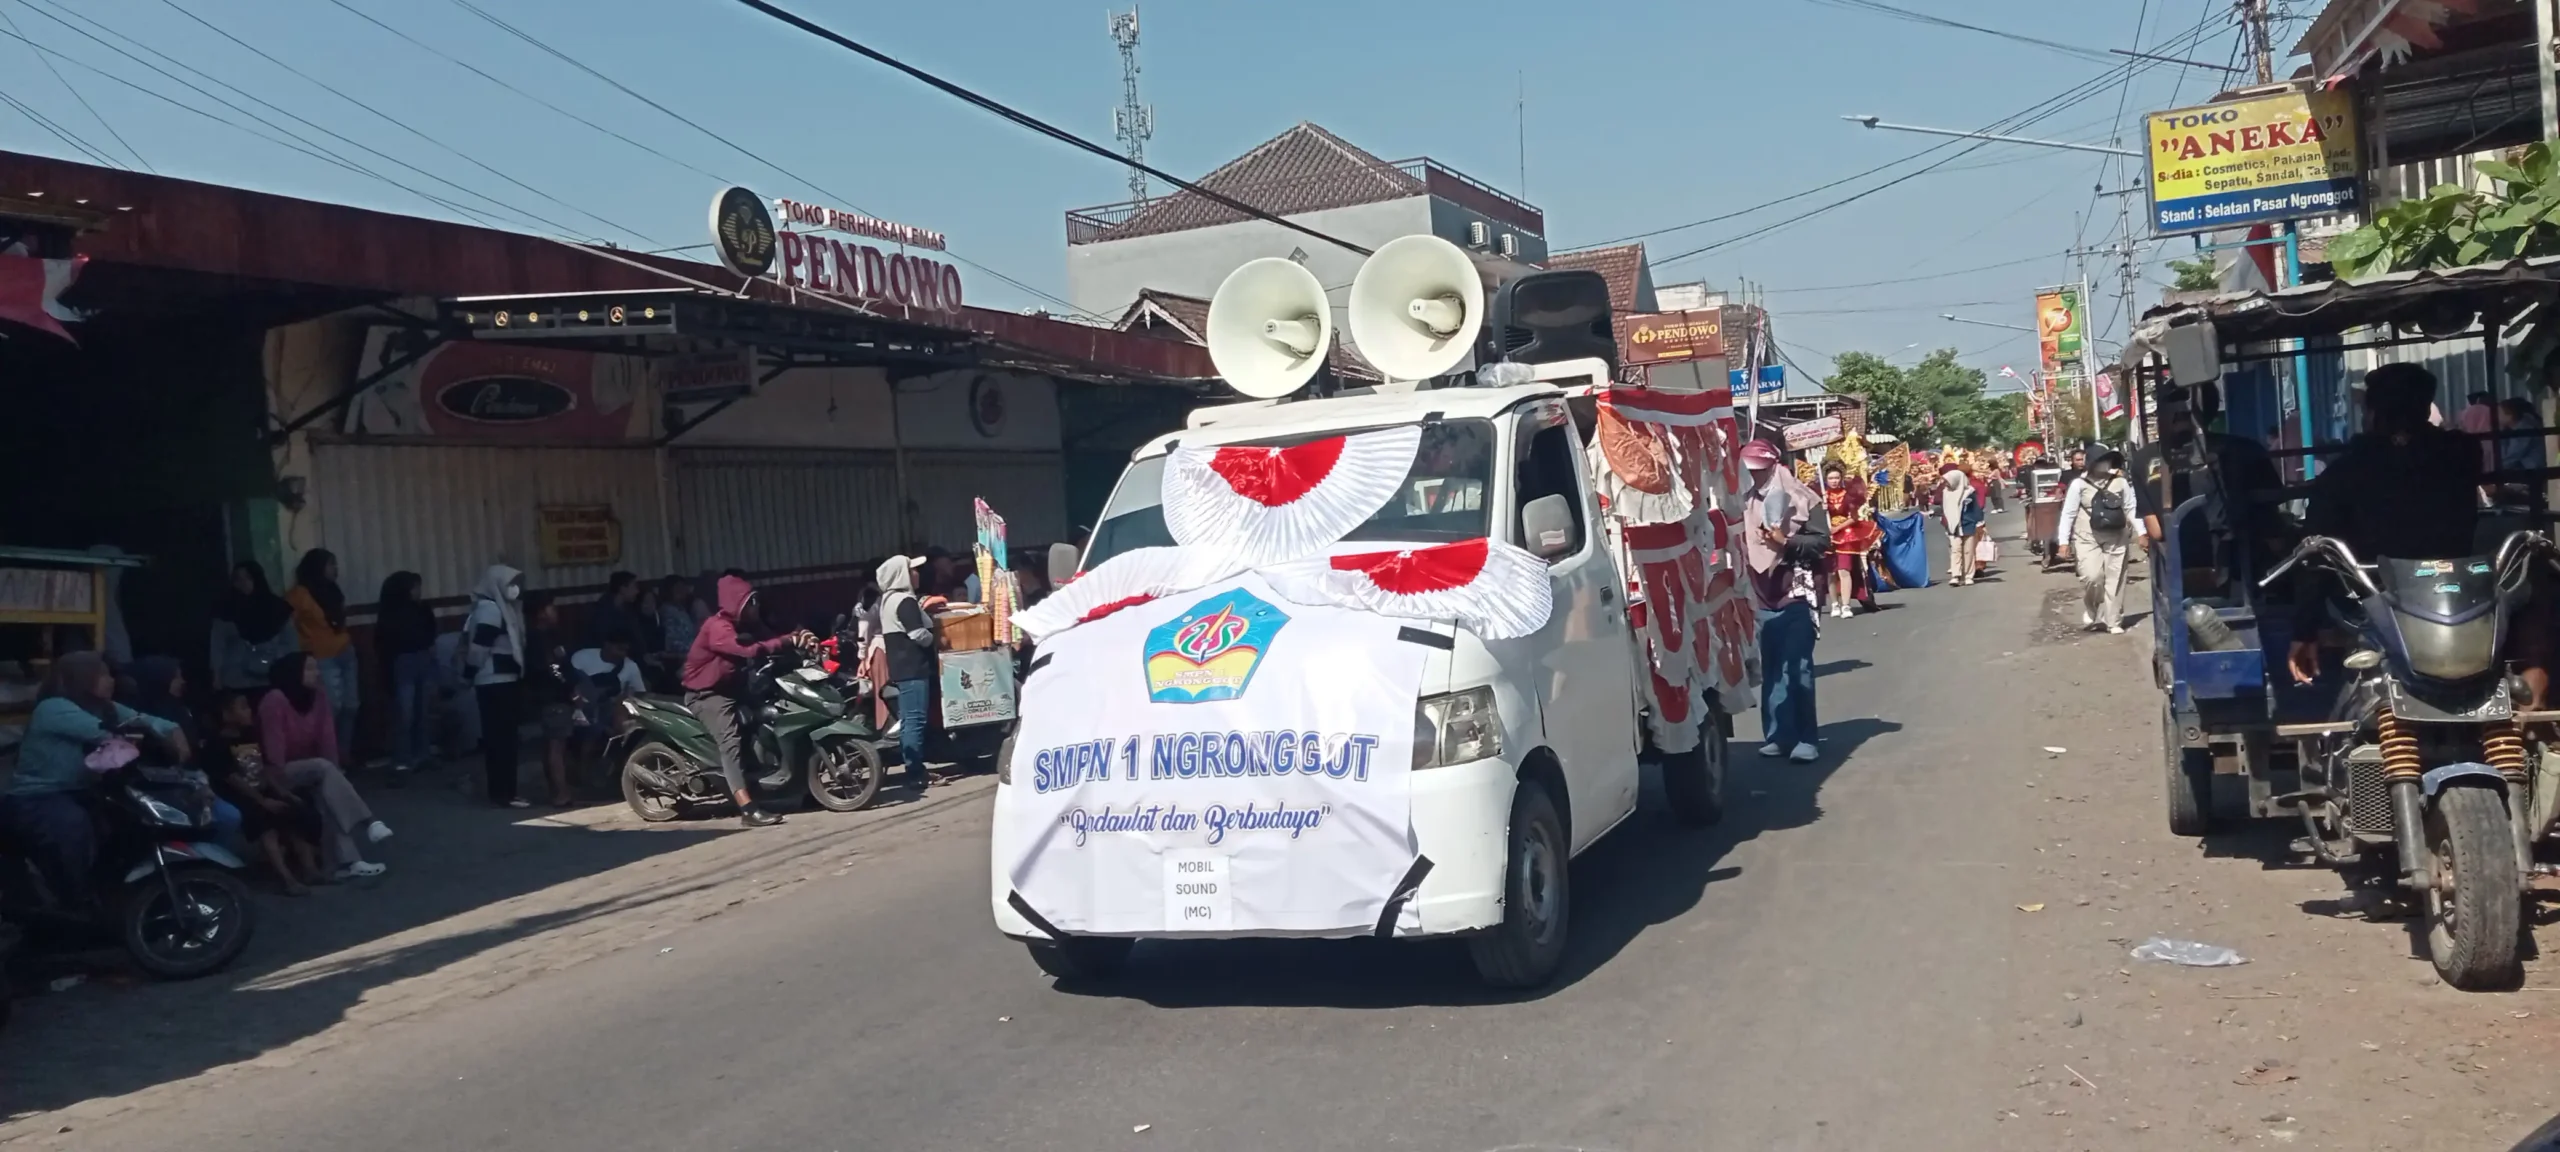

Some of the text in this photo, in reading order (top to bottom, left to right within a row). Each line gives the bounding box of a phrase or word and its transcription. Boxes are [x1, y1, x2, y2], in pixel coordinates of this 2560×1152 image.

[2164, 109, 2239, 130] TOKO
[2157, 168, 2193, 183] Sdia
[2203, 159, 2270, 176] Cosmetics,
[2204, 176, 2252, 191] Sepatu,
[2256, 168, 2302, 183] Sandal,
[2161, 206, 2195, 224] Stand
[2204, 201, 2250, 218] Selatan
[2253, 197, 2287, 212] Pasar
[2290, 186, 2354, 209] Ngronggot
[780, 198, 947, 251] TOKO PERHIASAN EMAS
[776, 230, 963, 315] PENDOWO
[1657, 324, 1719, 340] PENDOWO
[1757, 380, 1782, 389] ARMA
[1033, 729, 1380, 794] SMPN 1 NGRONGGOT
[1161, 803, 1200, 832] dan
[1204, 801, 1332, 847] Berbudaya"
[1177, 861, 1215, 873] MOBIL
[1175, 883, 1218, 895] SOUND
[1183, 905, 1212, 919] (MC)
